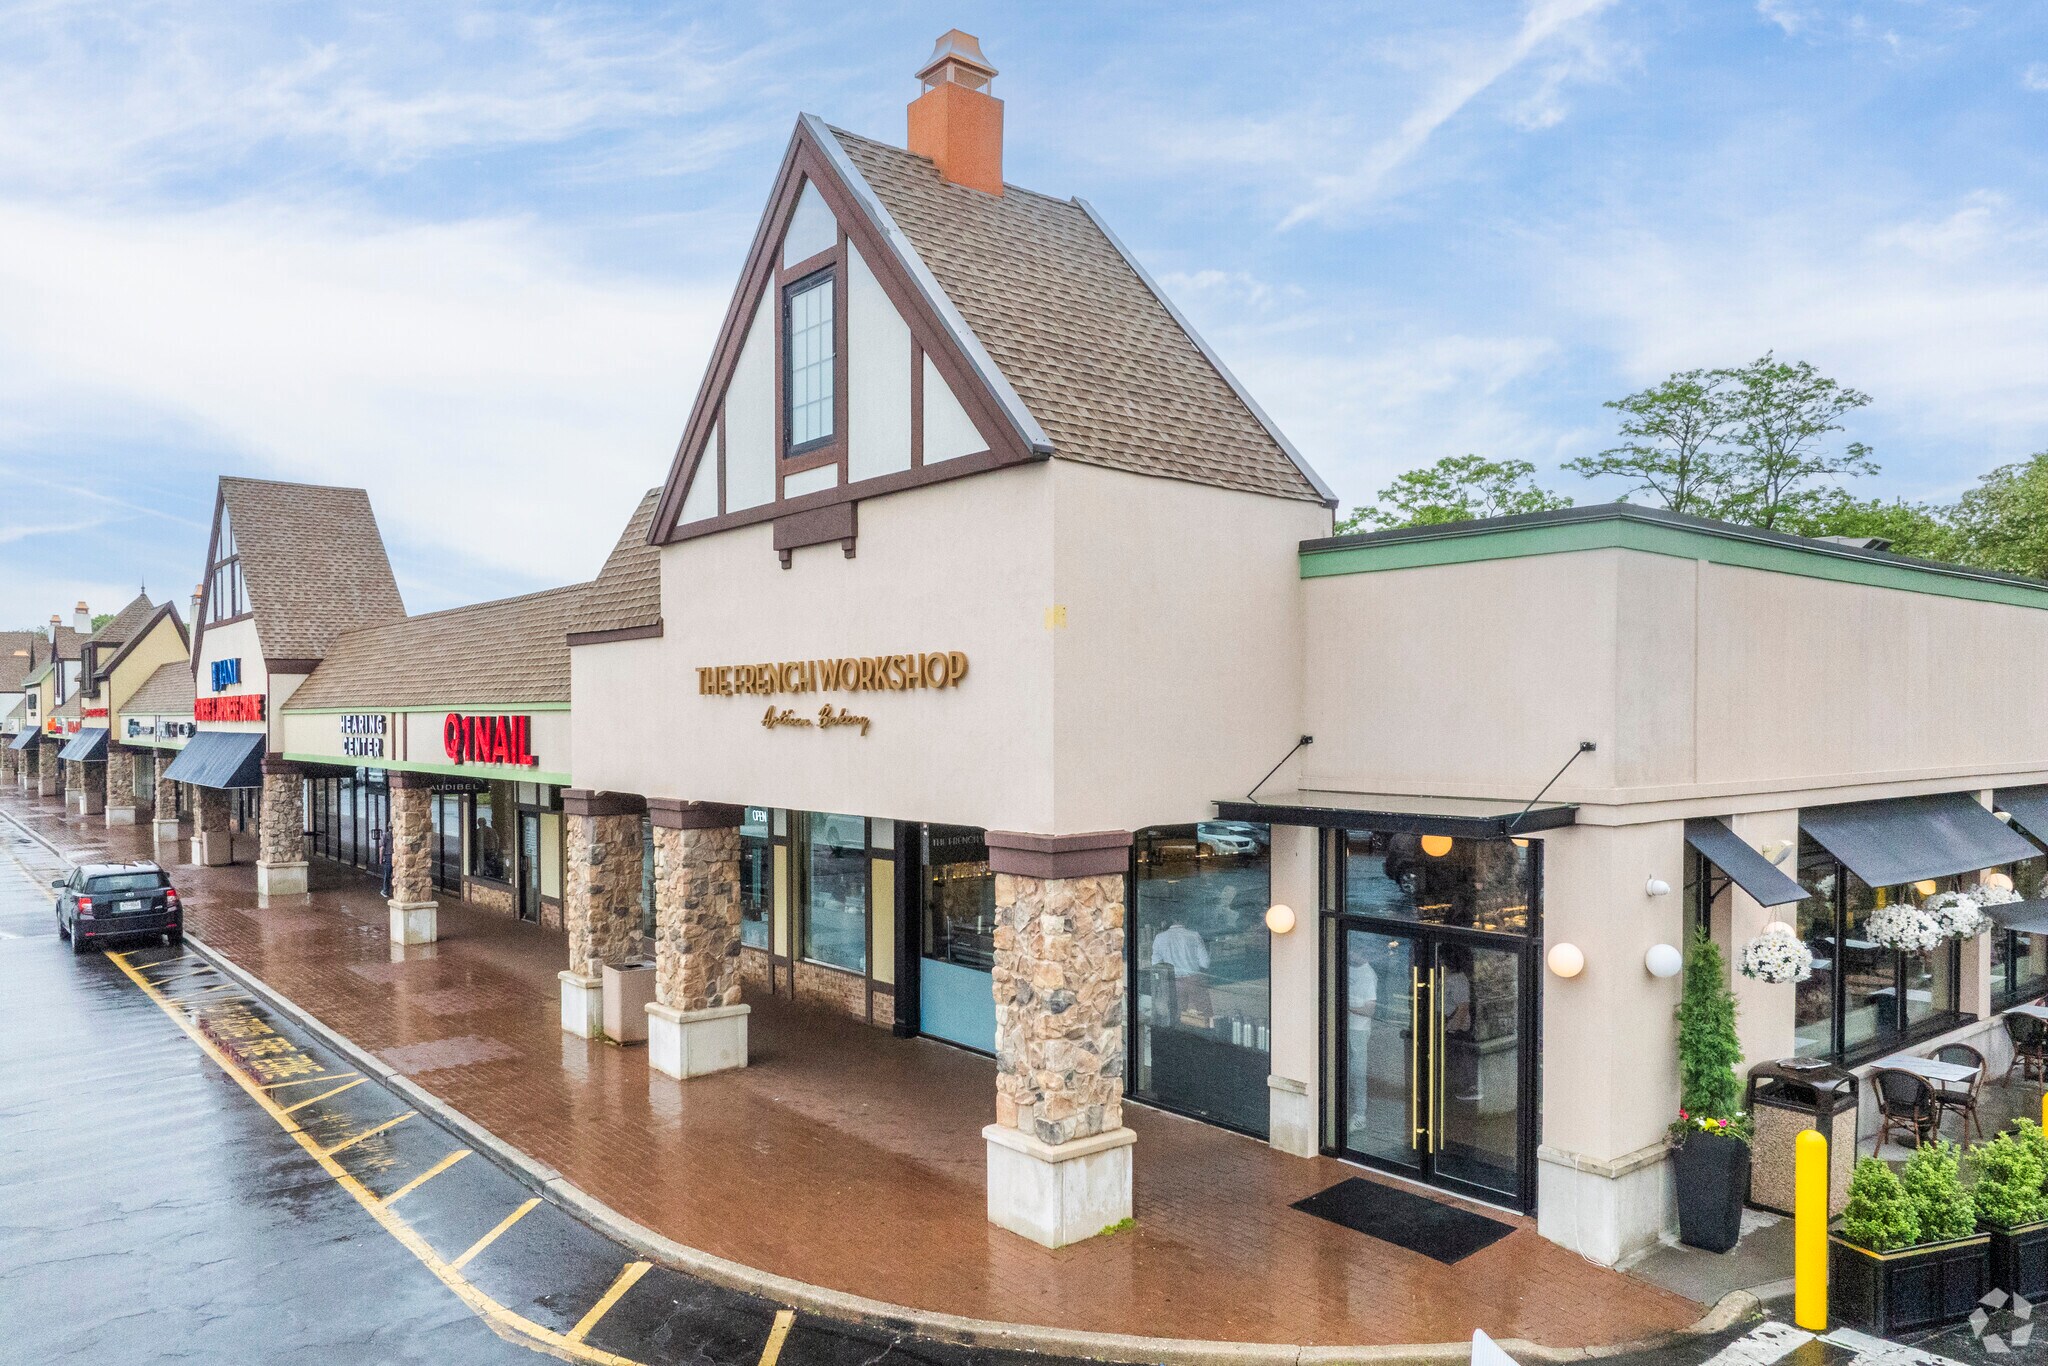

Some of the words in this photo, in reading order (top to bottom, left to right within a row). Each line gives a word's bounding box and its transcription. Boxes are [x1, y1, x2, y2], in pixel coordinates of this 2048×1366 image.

[694, 664, 733, 697] THE
[734, 661, 817, 695] FRENCH
[817, 651, 969, 692] WORKSHOP
[340, 714, 387, 735] HEARING
[817, 703, 871, 736] Bakery
[343, 736, 384, 757] CENTER
[430, 783, 480, 791] AUDIBEL
[752, 809, 768, 823] OPEN
